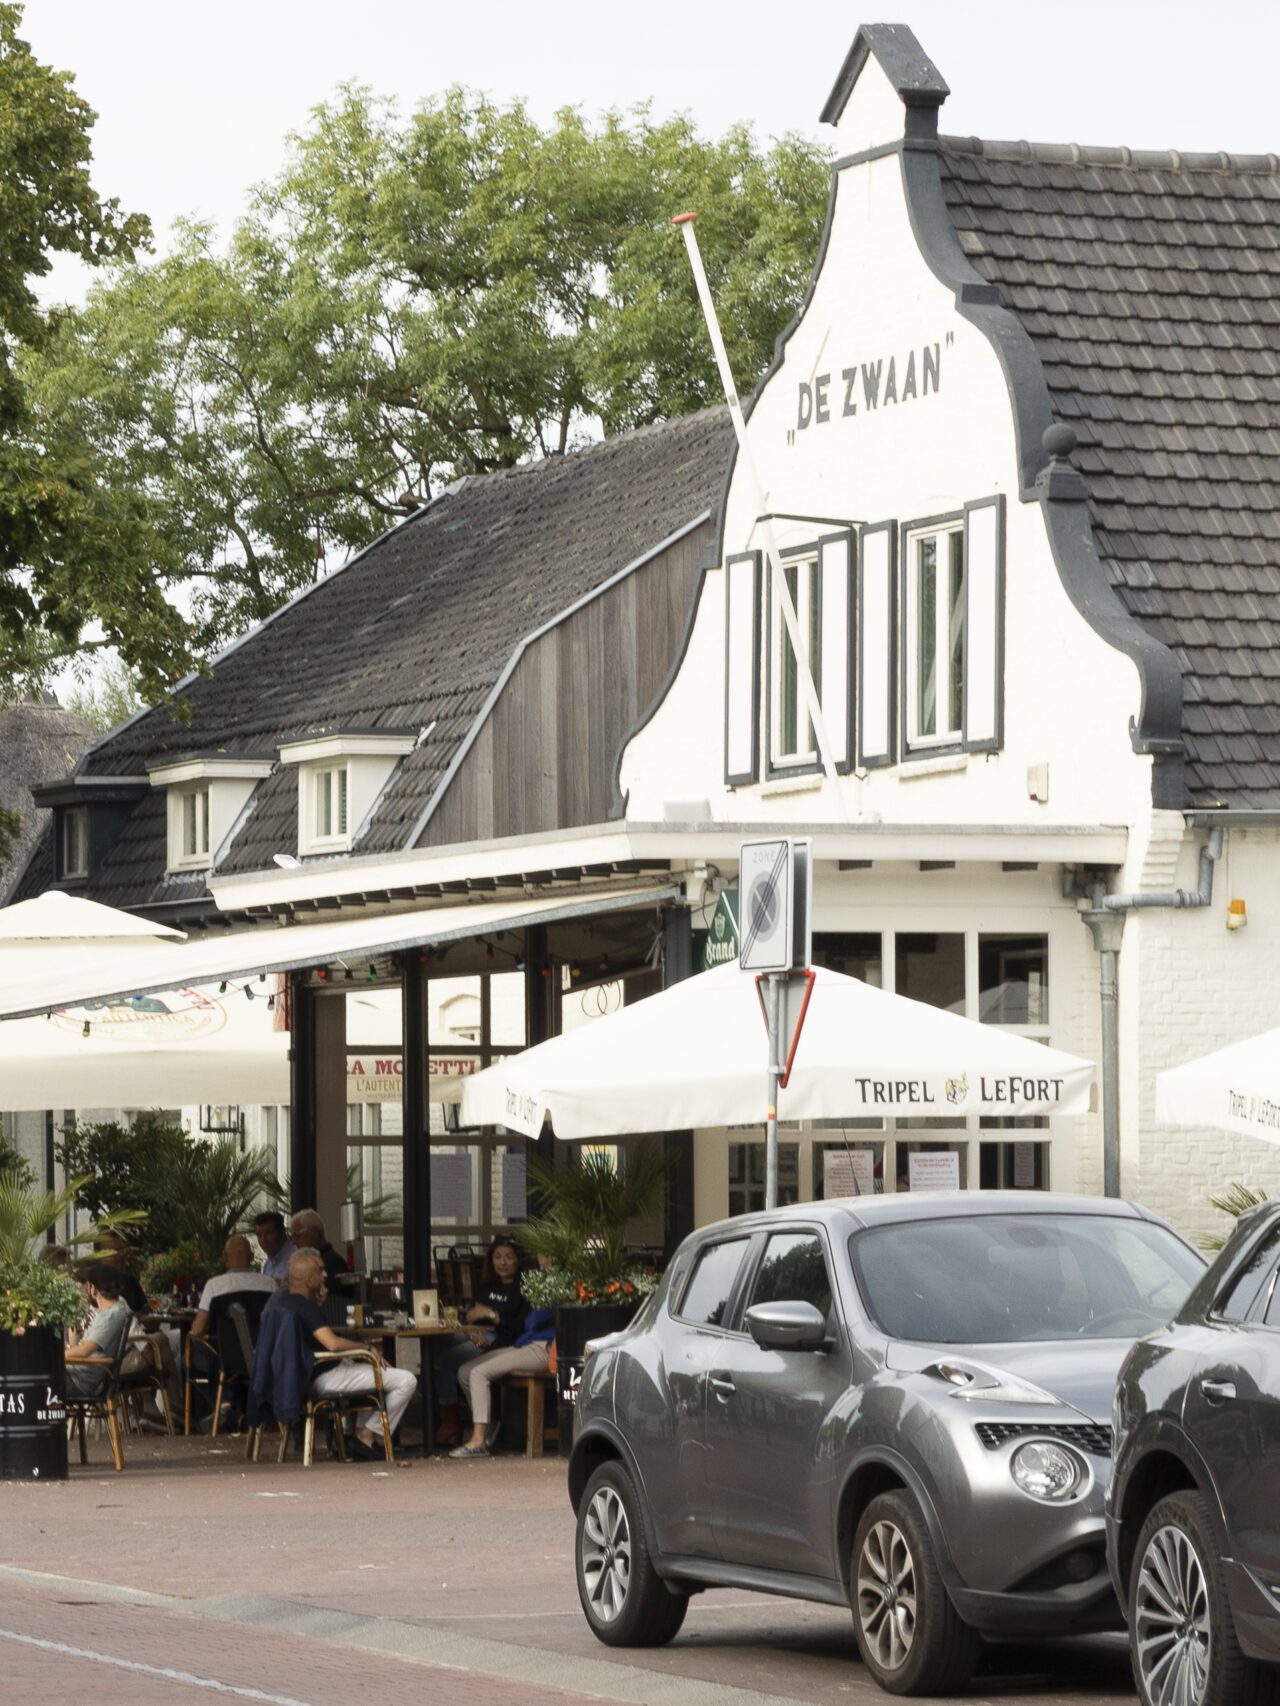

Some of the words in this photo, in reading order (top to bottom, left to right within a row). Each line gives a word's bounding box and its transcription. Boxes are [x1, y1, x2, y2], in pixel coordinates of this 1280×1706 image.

[753, 851, 777, 864] ZONE
[705, 935, 735, 965] Brand
[375, 1060, 476, 1075] MOETTI
[37, 1410, 47, 1420] DE
